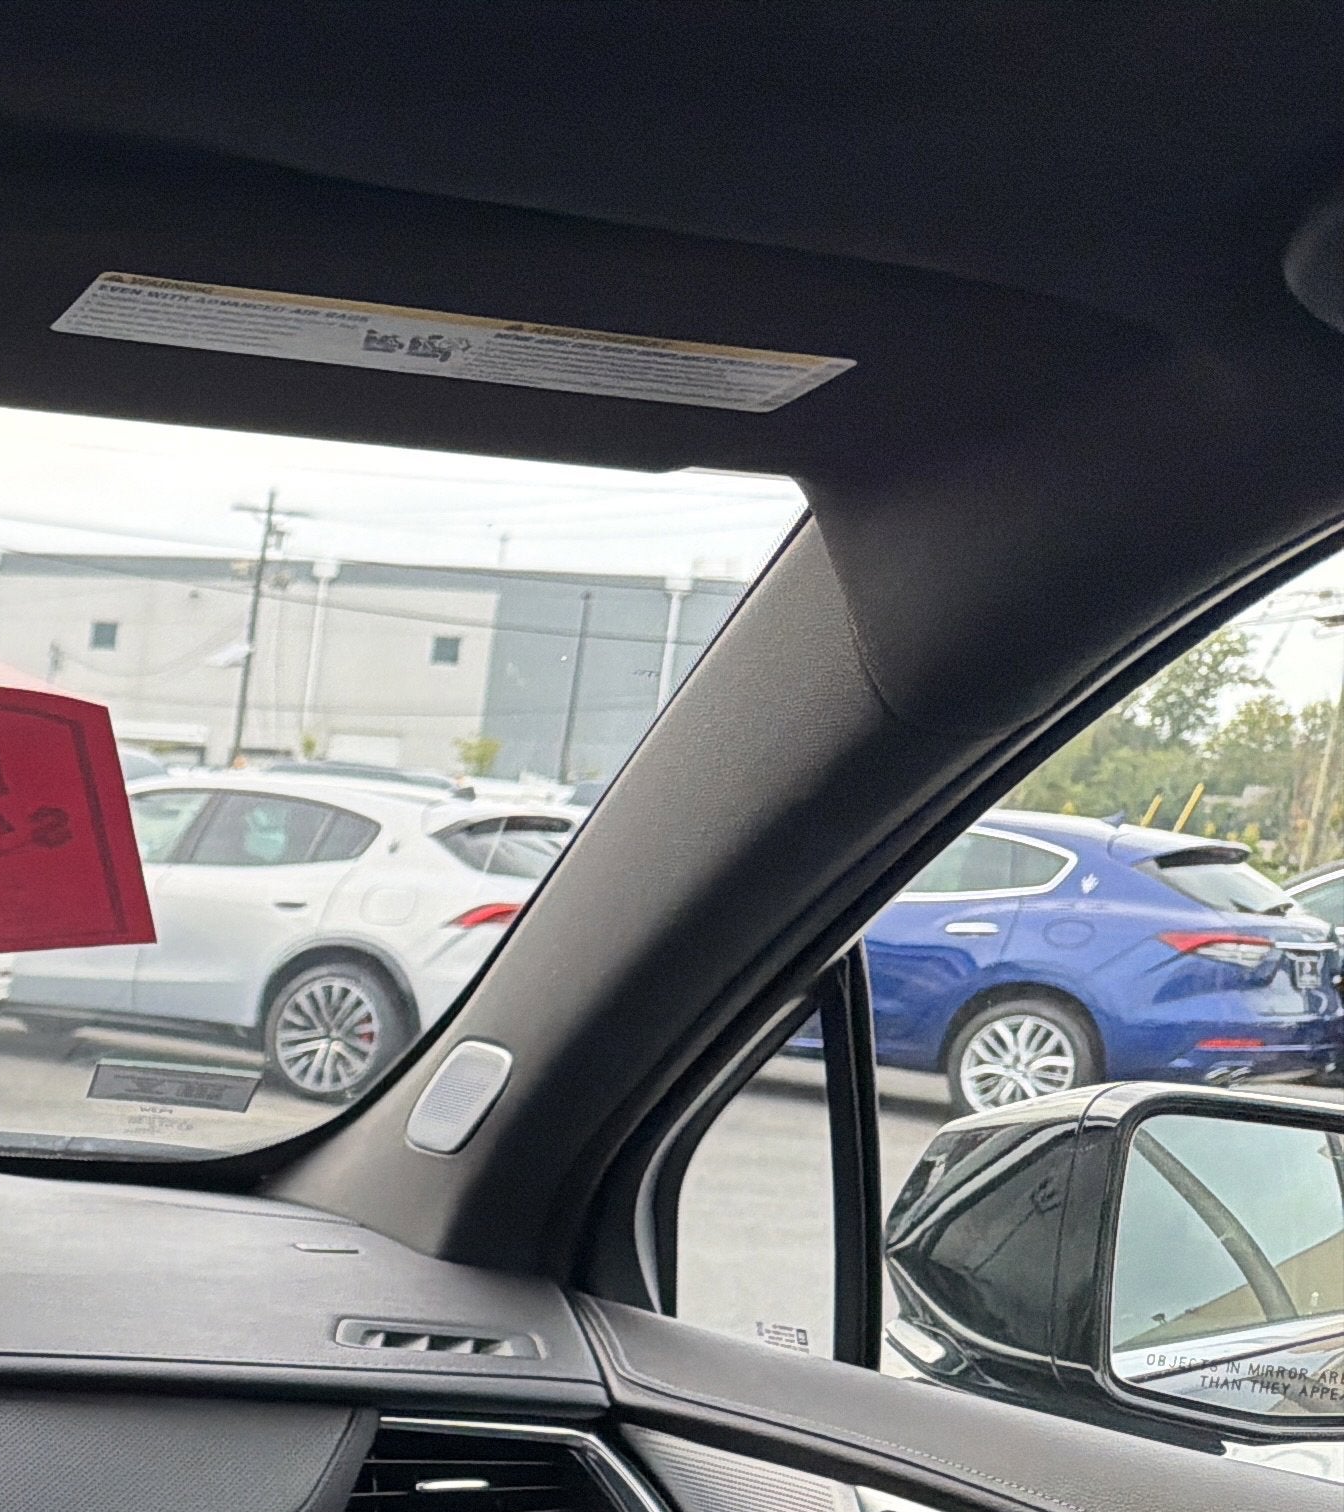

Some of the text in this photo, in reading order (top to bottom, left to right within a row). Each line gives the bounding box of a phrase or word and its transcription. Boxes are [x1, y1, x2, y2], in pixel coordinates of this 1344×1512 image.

[1146, 1353, 1218, 1373] OBJECTS
[1226, 1362, 1240, 1375] IN
[1247, 1362, 1309, 1381] MIRROR
[1200, 1375, 1243, 1392] THAN
[1250, 1379, 1290, 1397] THEY
